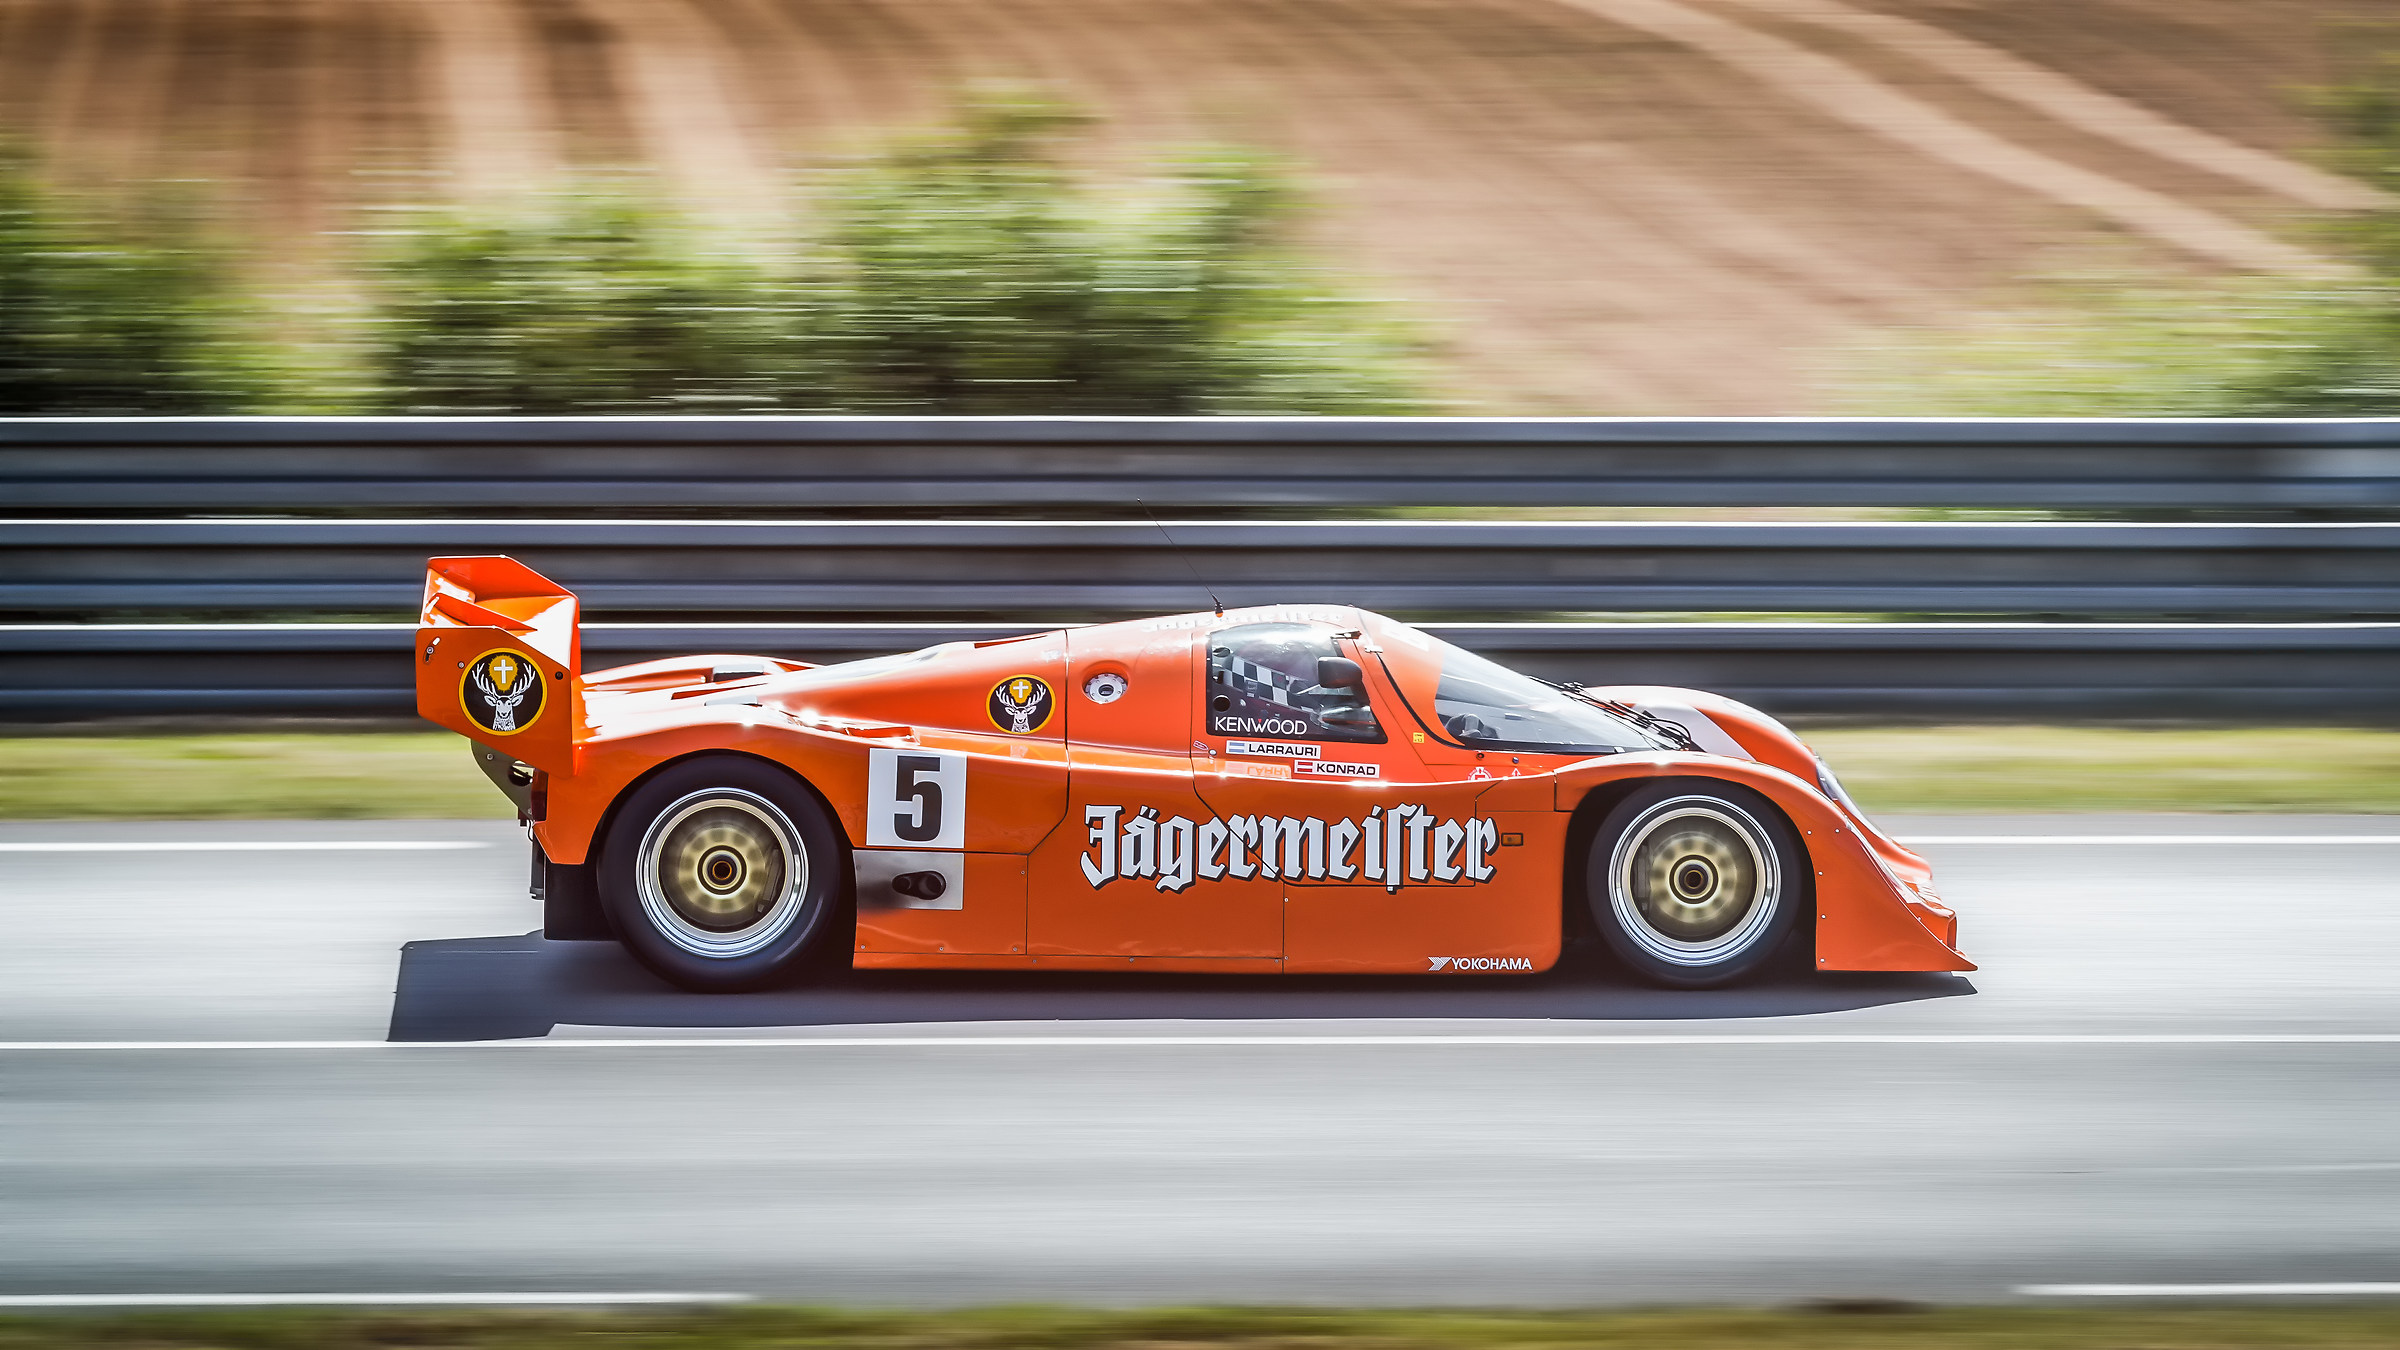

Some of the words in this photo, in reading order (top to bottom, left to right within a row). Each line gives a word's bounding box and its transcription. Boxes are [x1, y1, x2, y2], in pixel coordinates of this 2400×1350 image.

[1215, 716, 1307, 734] KENWOOD
[1249, 743, 1317, 756] LARRAURI
[1317, 763, 1376, 775] KONRAD
[894, 755, 943, 842] 5
[1451, 957, 1533, 971] YOKOHAMA
